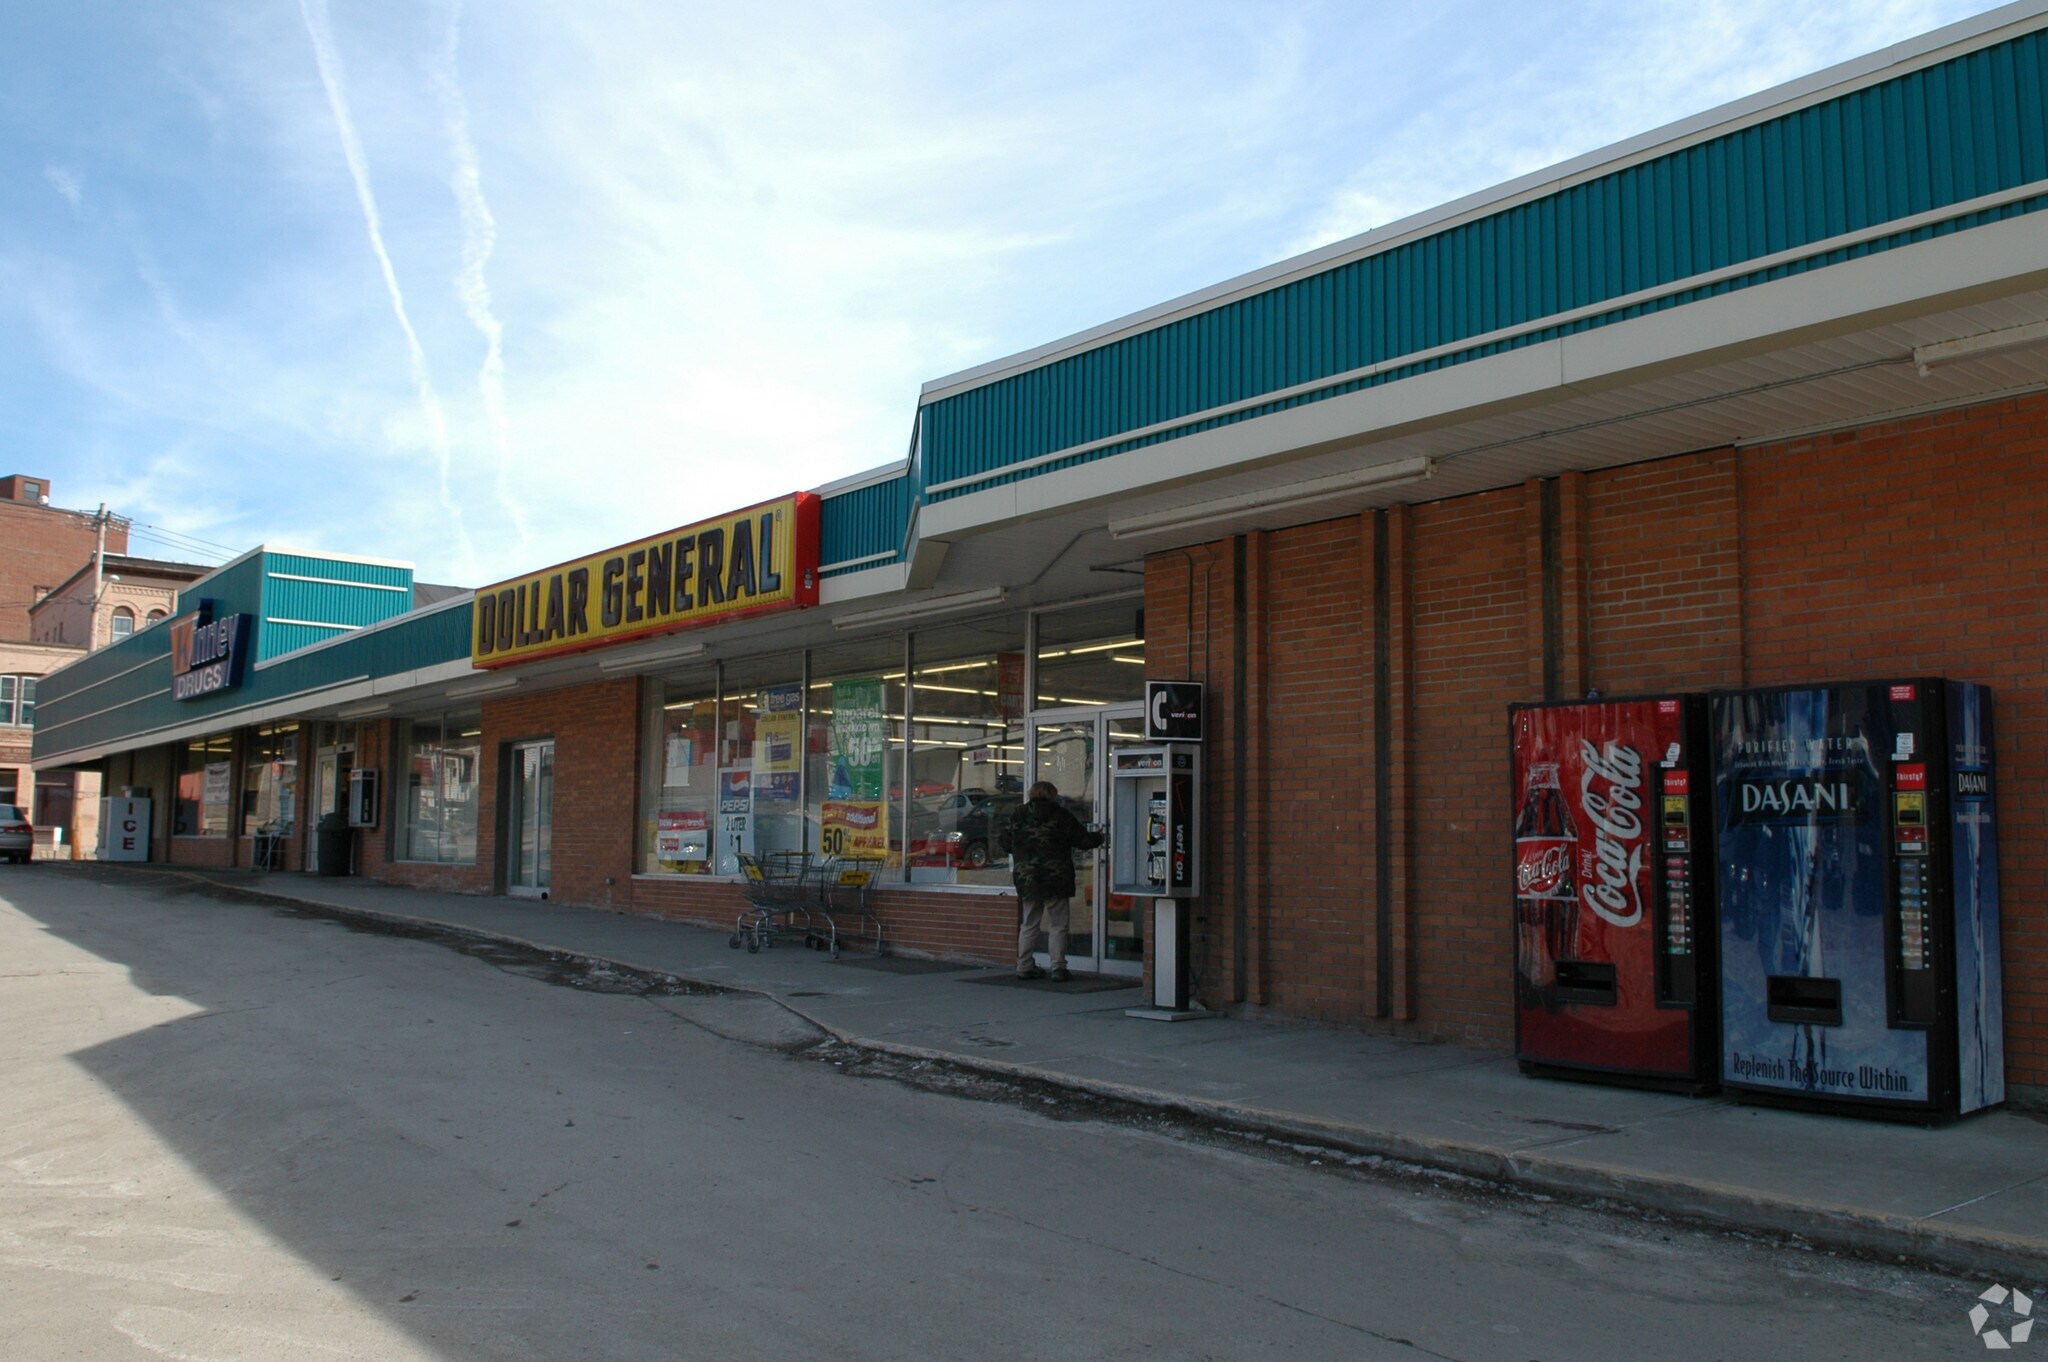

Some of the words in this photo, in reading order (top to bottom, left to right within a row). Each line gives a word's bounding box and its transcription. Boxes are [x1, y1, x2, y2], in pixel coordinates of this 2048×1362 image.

[478, 567, 589, 655] DOLLAR
[601, 513, 781, 628] GENERAL
[176, 664, 222, 698] DRUGS
[770, 692, 785, 703] free
[786, 692, 800, 705] gas
[836, 703, 881, 723] apparel
[1171, 711, 1197, 720] verizon
[1737, 740, 1796, 754] PURIFIED
[1806, 737, 1853, 752] WATER
[1958, 772, 1987, 794] DASANI
[721, 800, 750, 812] PEPSI
[1742, 780, 1848, 816] DASANI
[123, 802, 137, 850] ICE
[1175, 823, 1186, 881] verizon
[1582, 849, 1593, 878] Drink!
[1734, 1052, 1784, 1080] Replenish
[1788, 1059, 1808, 1083] The
[1813, 1062, 1855, 1088] Source
